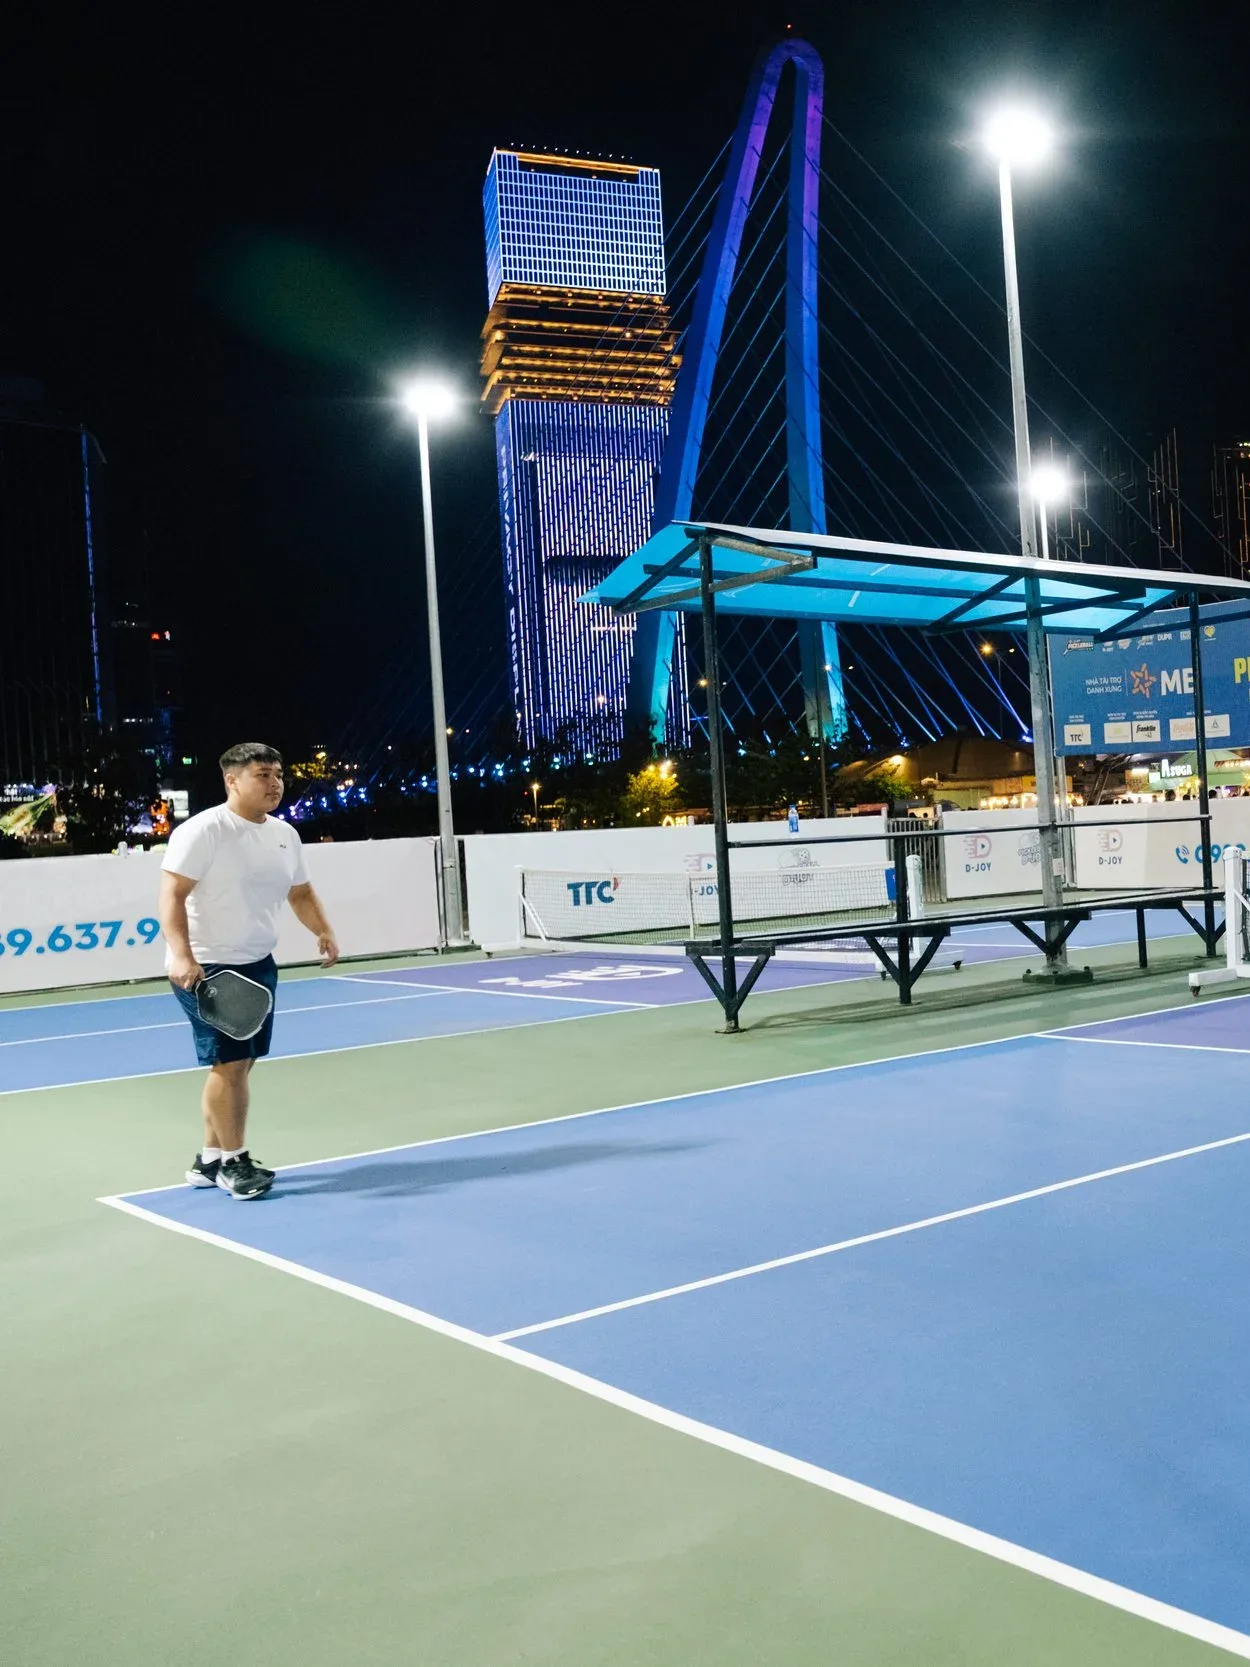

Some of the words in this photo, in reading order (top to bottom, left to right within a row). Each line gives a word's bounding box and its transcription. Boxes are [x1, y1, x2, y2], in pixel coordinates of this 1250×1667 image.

[1086, 686, 1104, 694] DANH
[1070, 733, 1082, 742] TTC
[1098, 856, 1123, 866] D-JOY
[965, 861, 992, 873] D-JOY
[566, 880, 615, 906] TTC
[0, 917, 161, 957] 9.637.9
